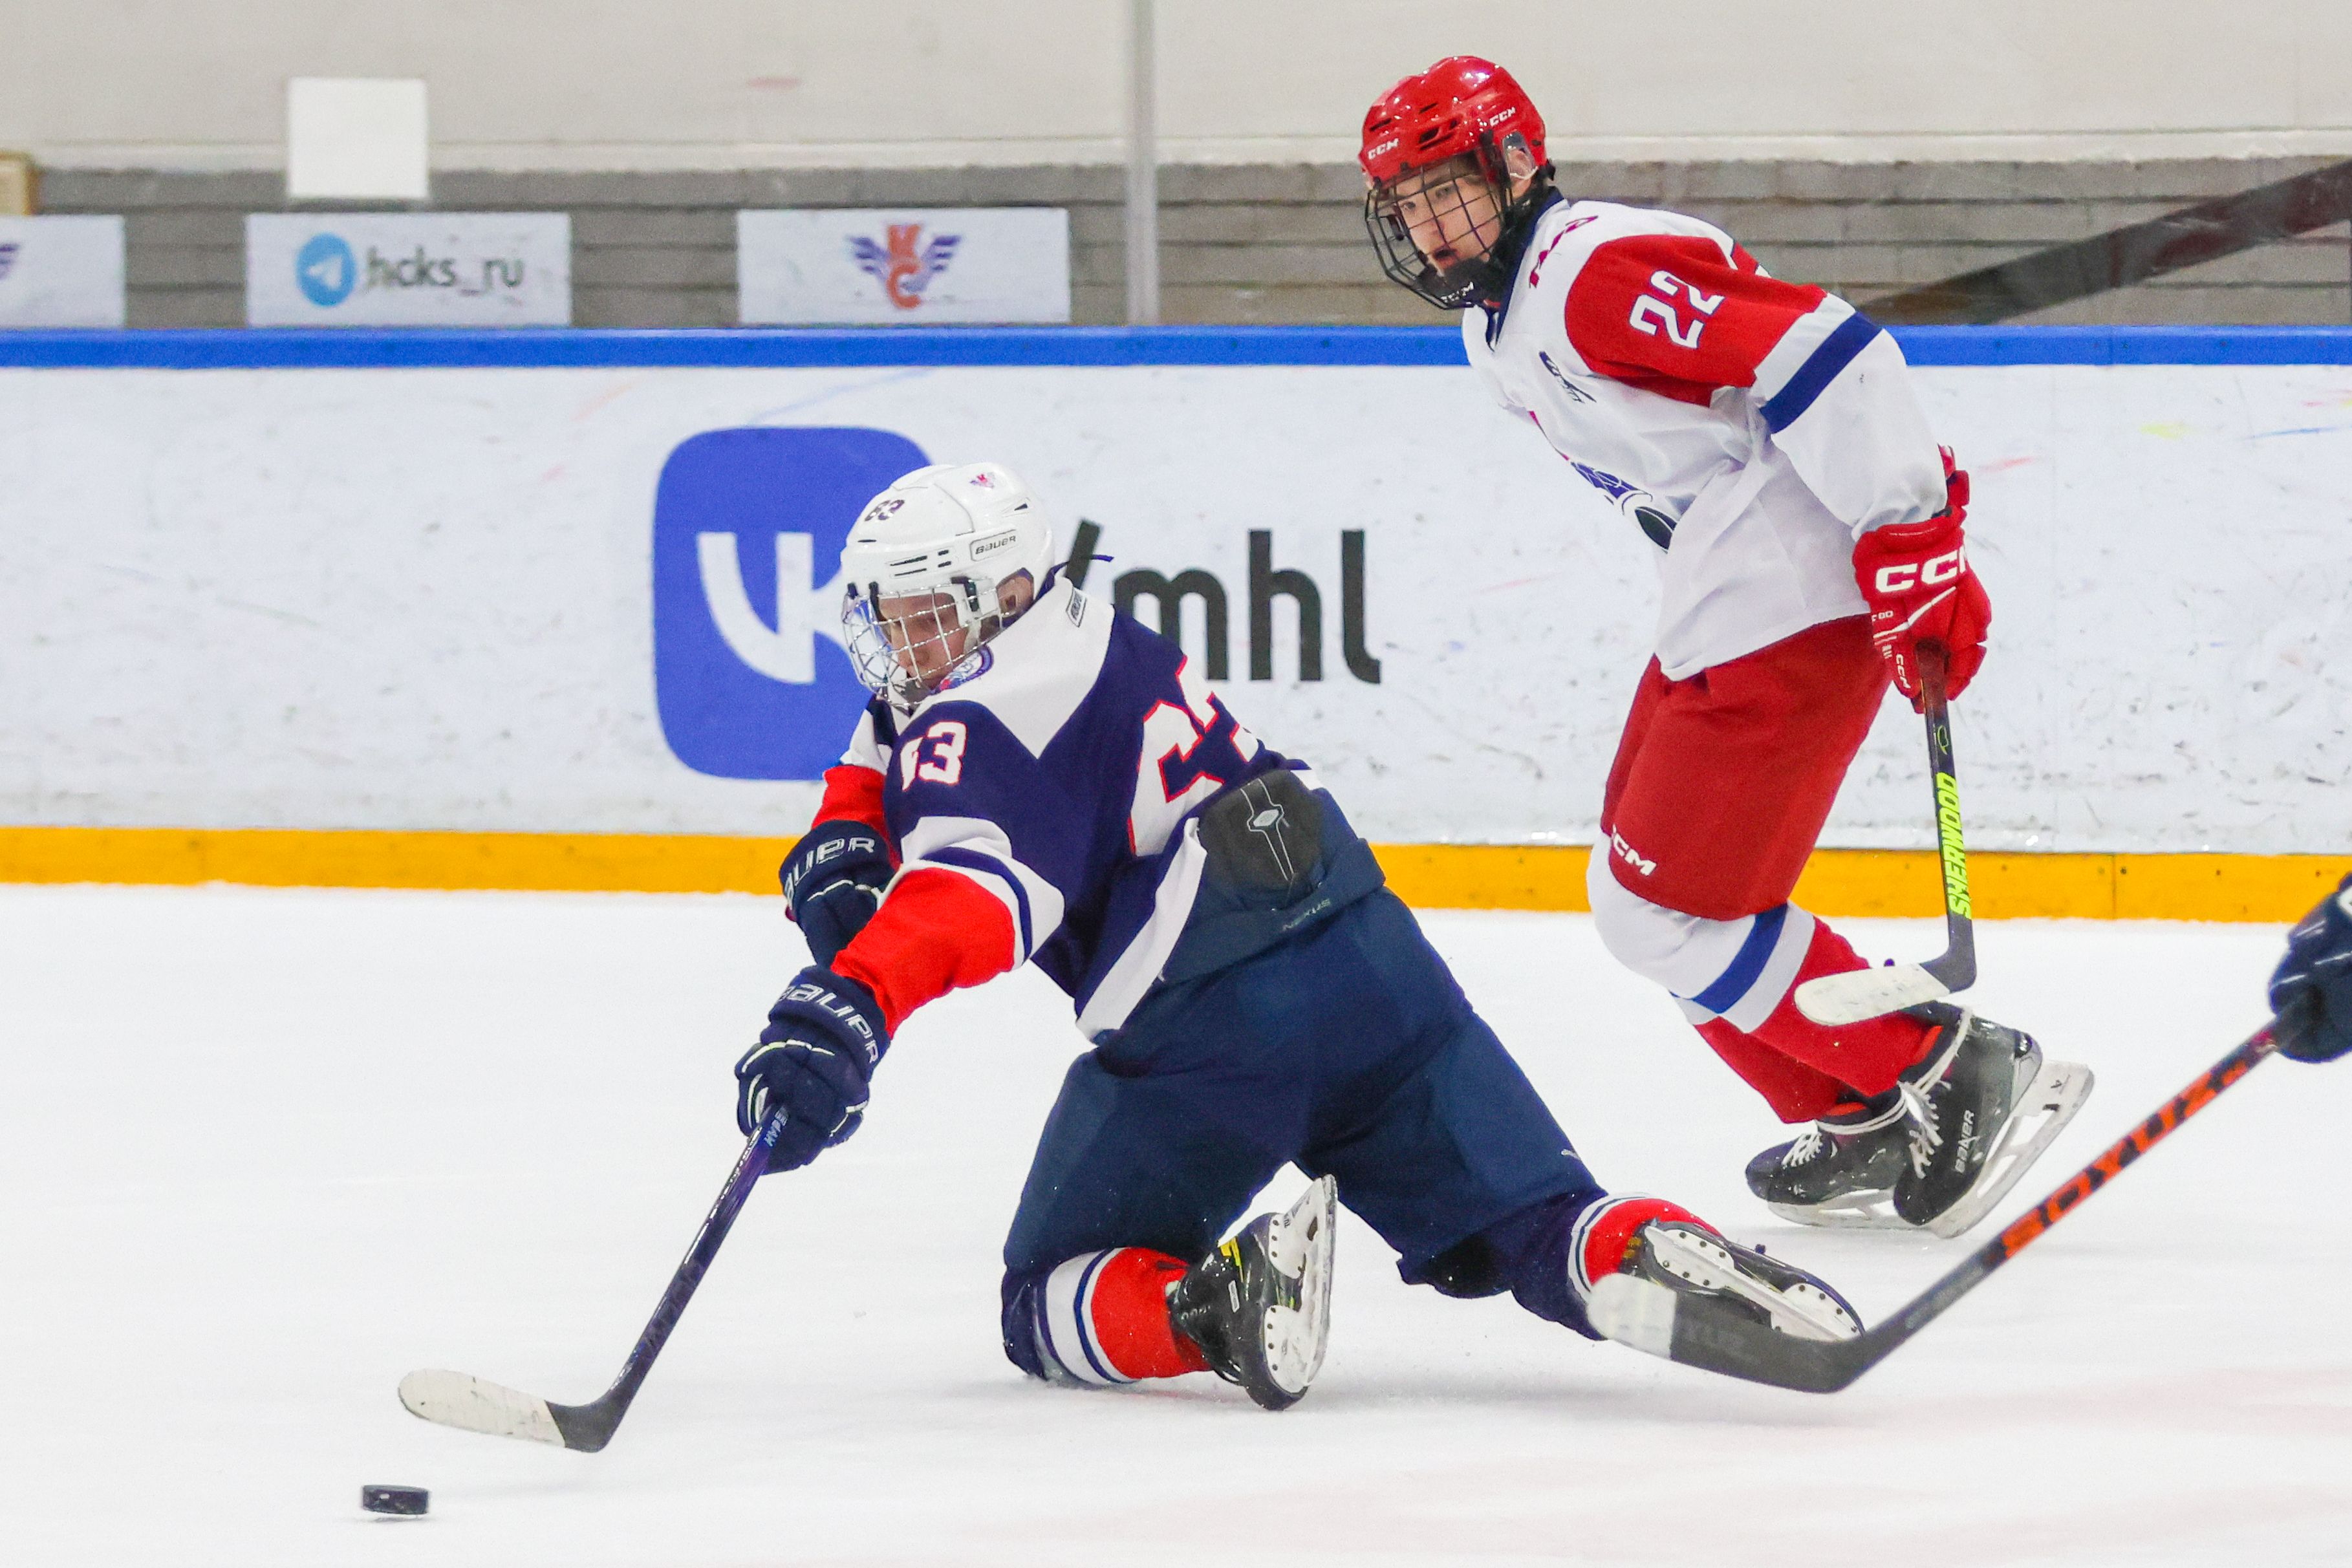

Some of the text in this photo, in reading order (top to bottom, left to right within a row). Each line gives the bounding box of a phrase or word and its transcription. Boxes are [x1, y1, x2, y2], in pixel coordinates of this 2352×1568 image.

[1489, 107, 1516, 127] CCM
[1368, 137, 1399, 160] CCM
[366, 245, 523, 297] hcks_ru
[1629, 270, 1726, 350] 22
[1612, 822, 1657, 876] CM
[1936, 771, 1972, 920] SHERWOOD
